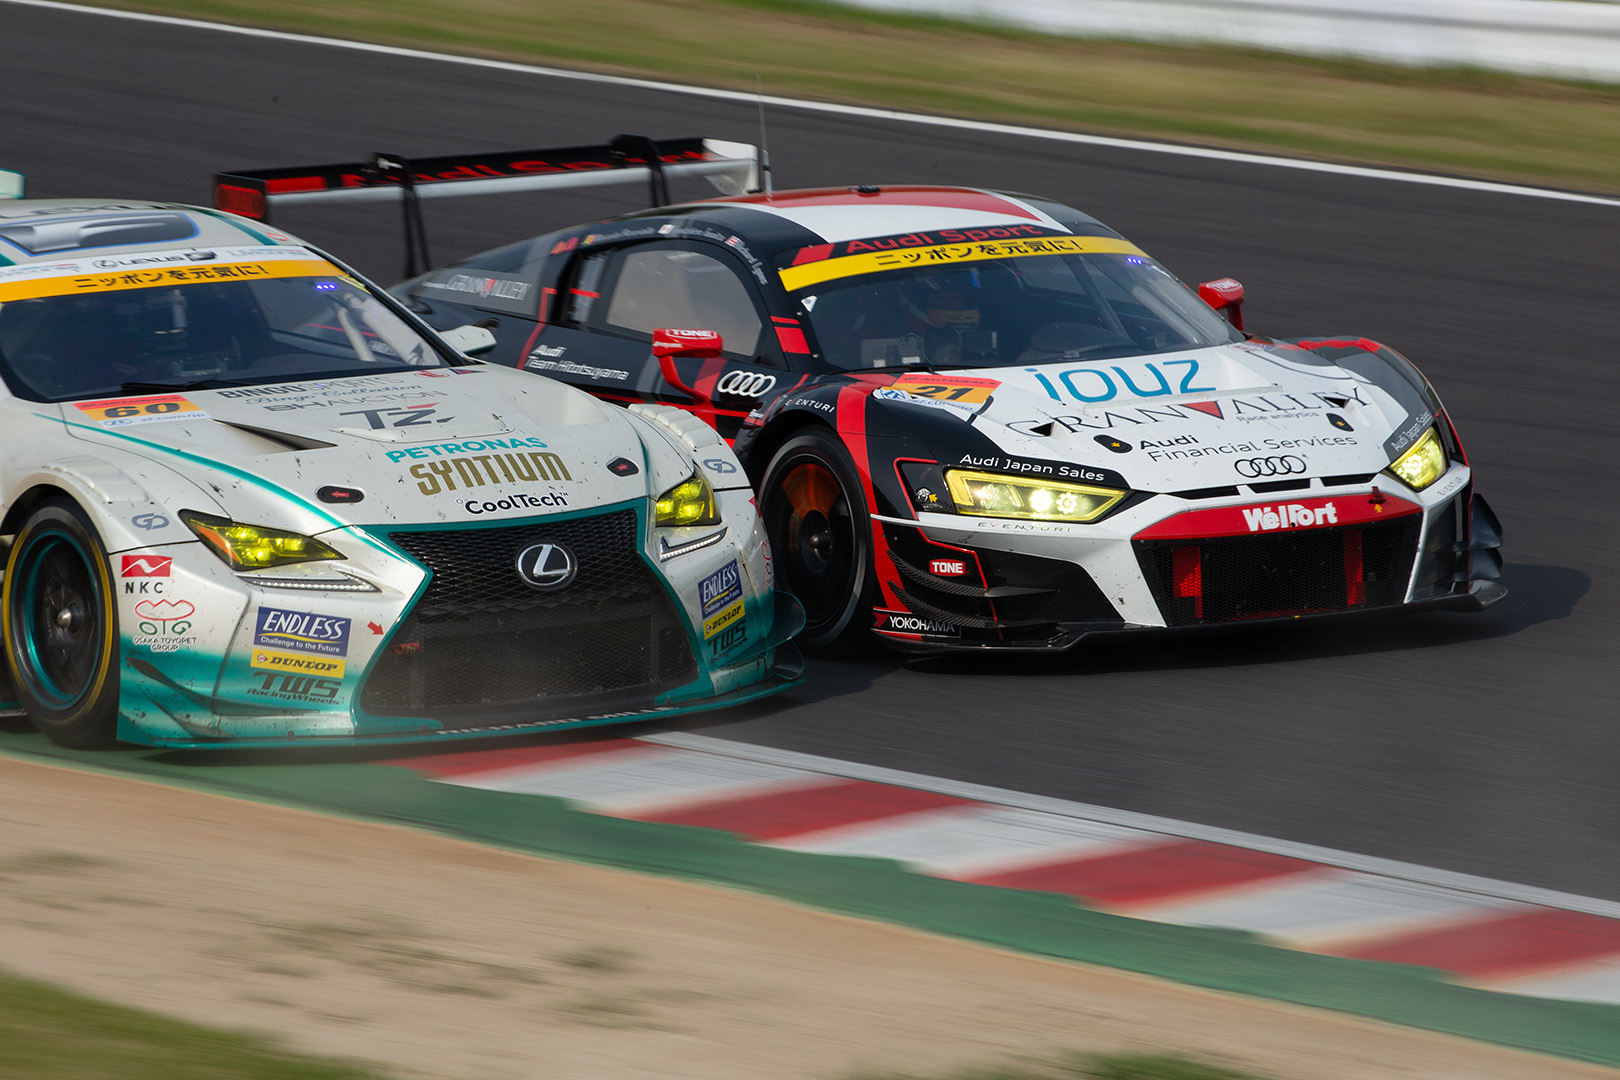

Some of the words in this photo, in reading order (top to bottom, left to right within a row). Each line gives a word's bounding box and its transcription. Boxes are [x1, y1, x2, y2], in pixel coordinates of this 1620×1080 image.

[846, 232, 936, 254] Audi
[940, 223, 1043, 244] Sport
[875, 238, 1083, 266] ニッポンを元気に!
[74, 264, 269, 288] ニッポンを元気に!
[532, 344, 567, 358] Audi
[525, 356, 557, 371] Team
[916, 385, 975, 401] 21
[104, 402, 181, 418] 60
[385, 437, 548, 463] PETRONAS
[1140, 434, 1199, 450] Audi
[1147, 441, 1261, 463] Financial
[1263, 435, 1358, 451] Services
[409, 452, 572, 496] SYNTIUM
[959, 454, 999, 468] Audi
[1003, 459, 1053, 475] Japan
[1058, 466, 1106, 482] Sales
[931, 561, 964, 574] TONE
[703, 562, 737, 603] ENDLESS
[262, 610, 346, 640] ENDLESS
[711, 604, 742, 630] DUNLOP
[889, 616, 955, 633] YOKOHAMA
[134, 637, 159, 645] OSAKA
[160, 636, 197, 644] TOYOPET
[151, 644, 179, 652] GROUP
[260, 636, 295, 647] Challenge
[296, 640, 304, 648] to
[304, 642, 317, 650] the
[317, 643, 340, 653] Future
[707, 618, 747, 657] TWS
[270, 656, 338, 672] DUNLOP
[252, 671, 342, 699] TWS
